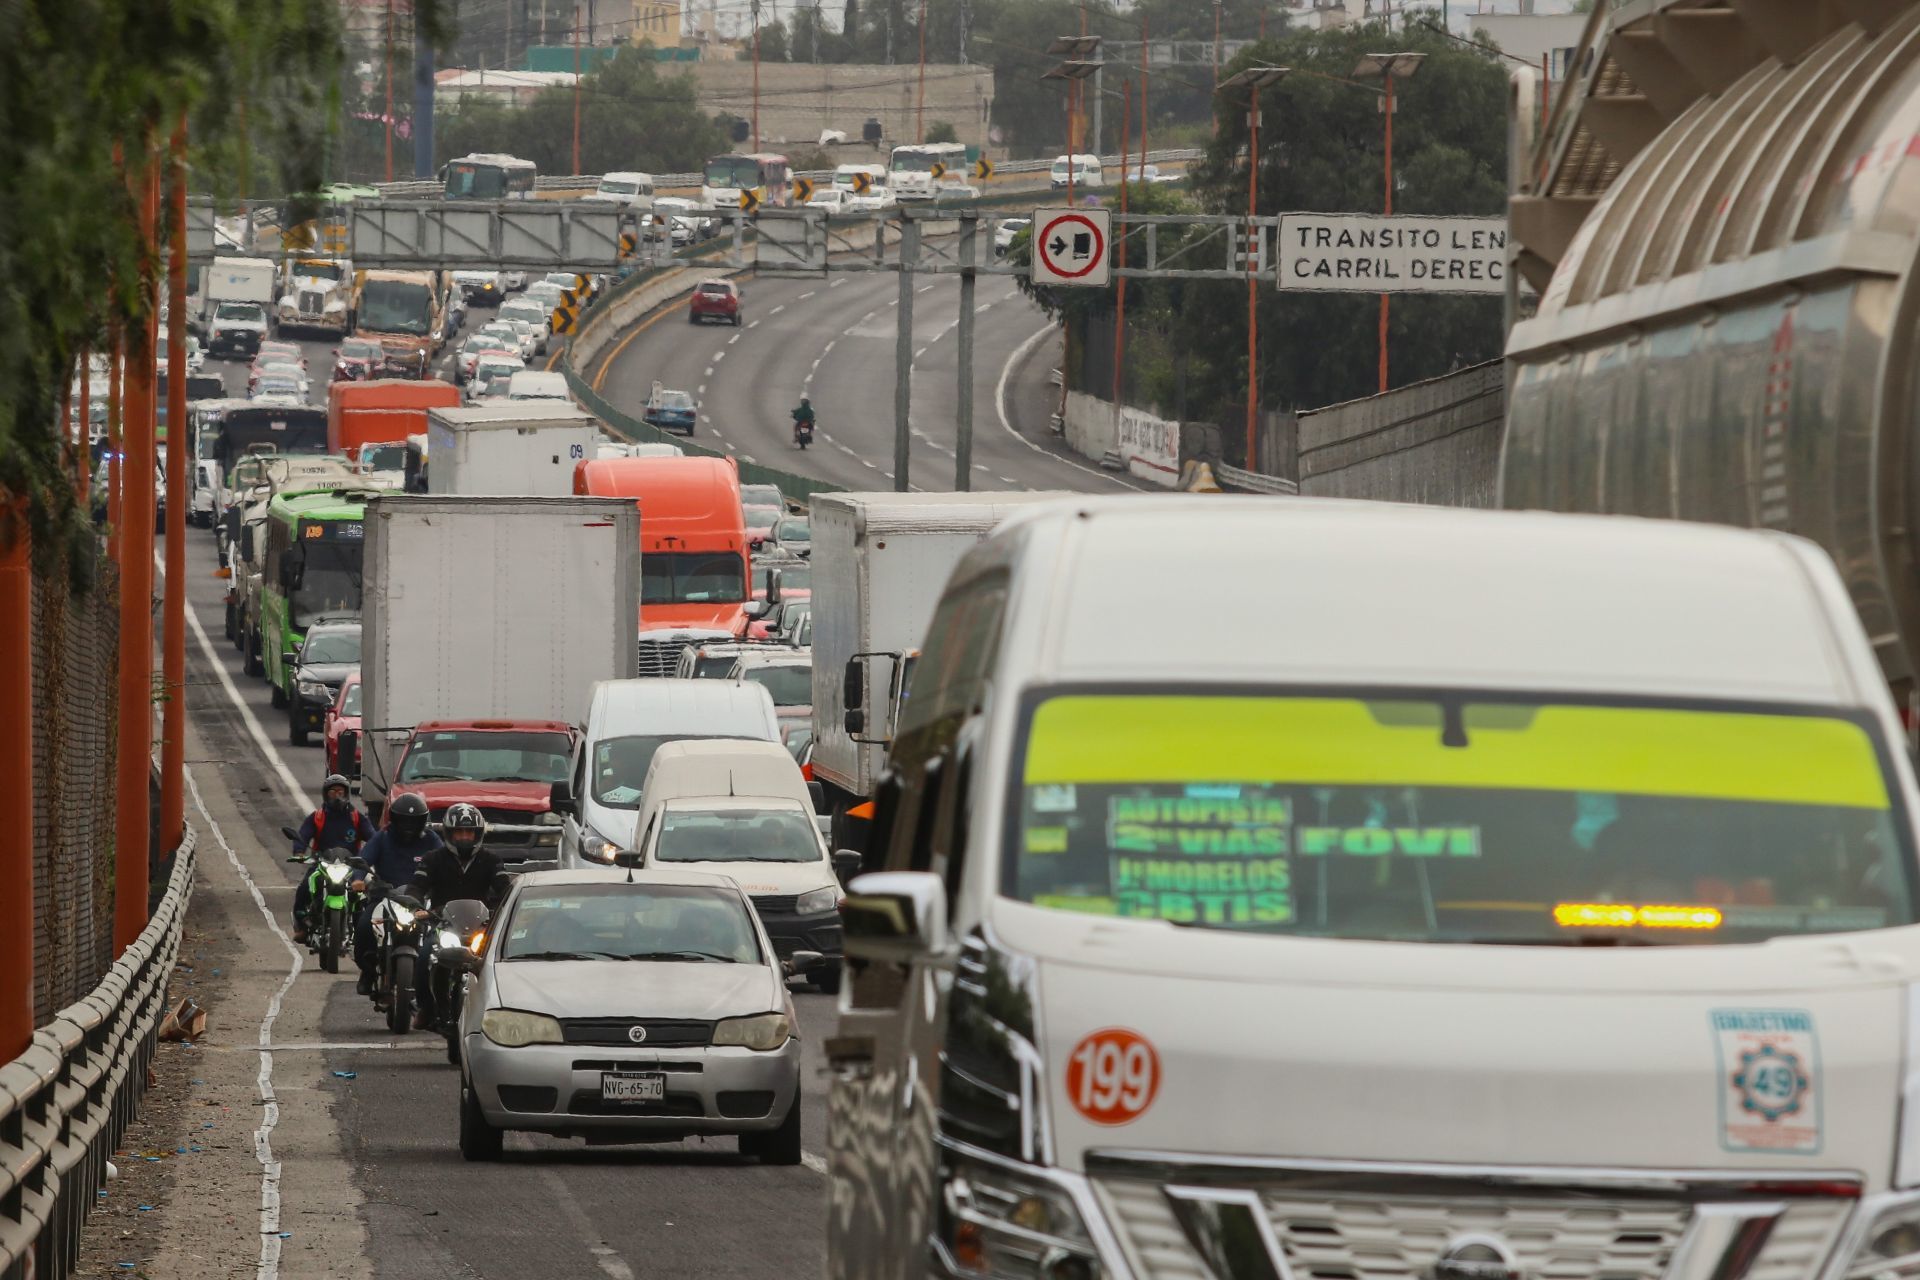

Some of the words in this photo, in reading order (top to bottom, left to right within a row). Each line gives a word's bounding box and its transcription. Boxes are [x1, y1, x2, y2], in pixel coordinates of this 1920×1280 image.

[1297, 226, 1440, 249] TRANSITO
[1294, 257, 1400, 279] CARRIL
[569, 444, 584, 459] 09
[1117, 797, 1287, 824] AUTOPISTA
[1177, 826, 1285, 855] VIAS
[1302, 826, 1476, 856] FOVI
[604, 1080, 662, 1096] NVG-65-70
[1074, 1039, 1153, 1112] 199
[1753, 1066, 1793, 1098] 49
